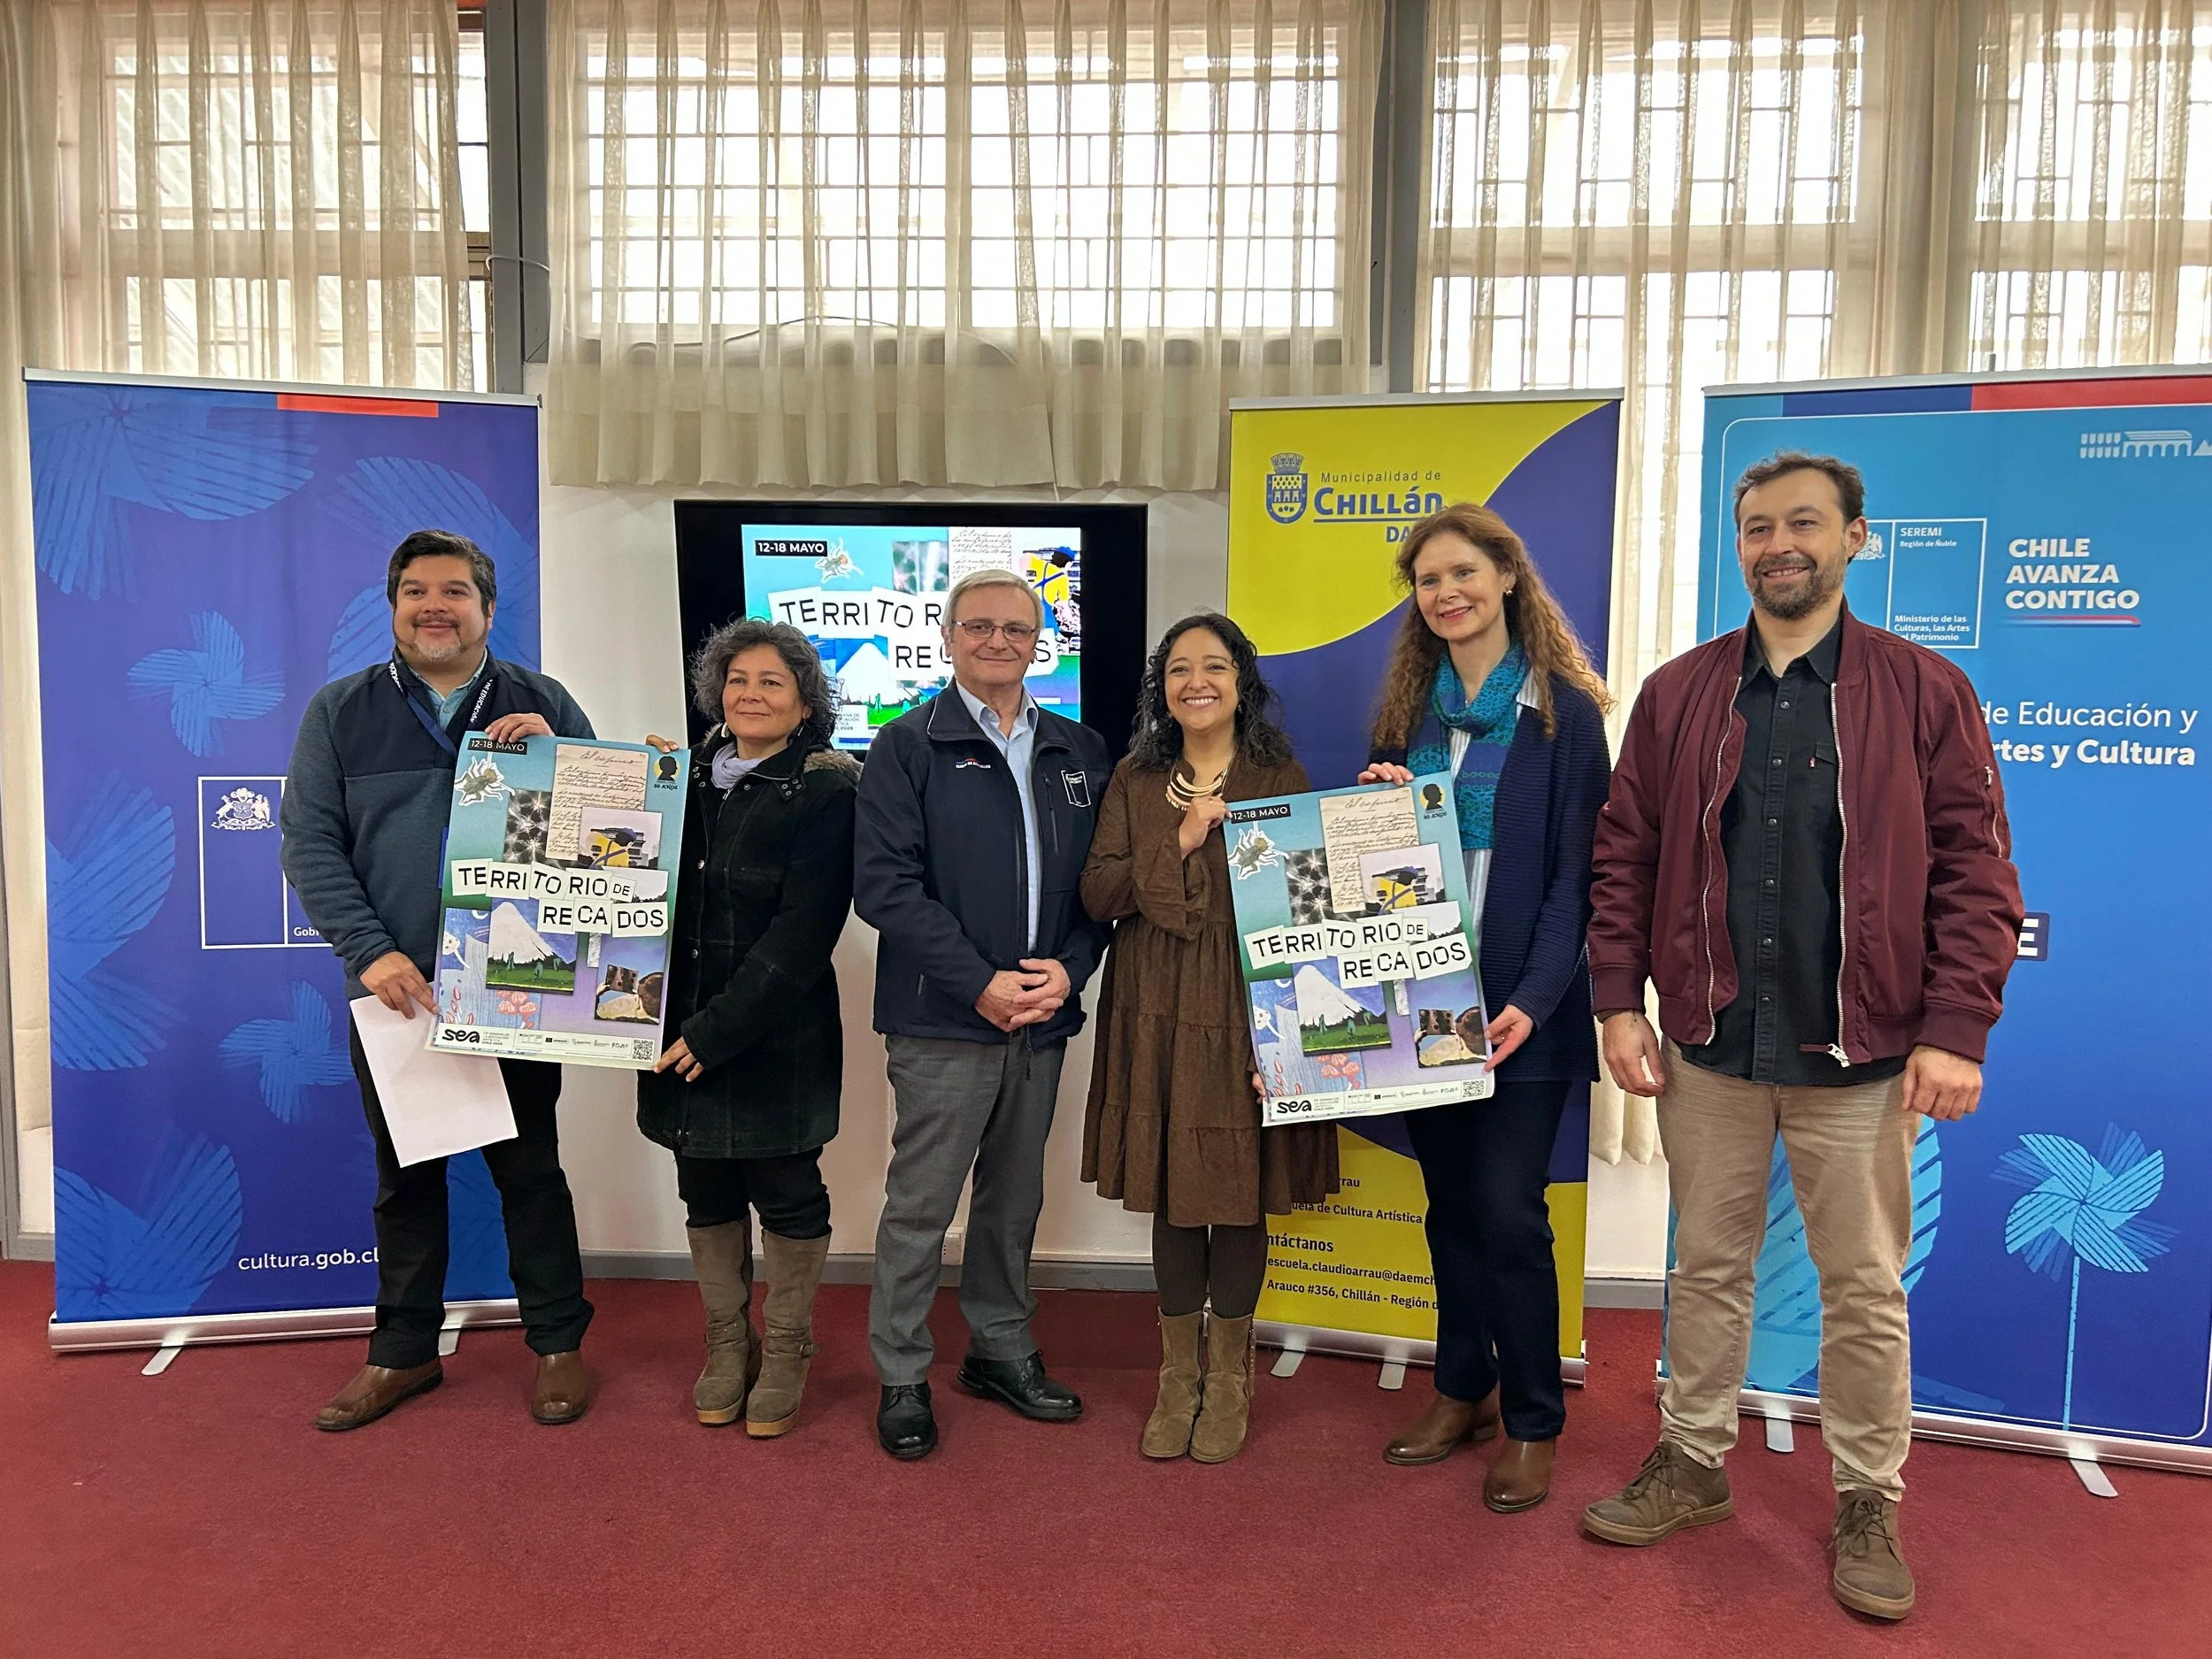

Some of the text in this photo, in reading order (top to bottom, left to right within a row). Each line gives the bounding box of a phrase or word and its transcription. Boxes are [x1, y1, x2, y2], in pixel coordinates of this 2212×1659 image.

[1321, 471, 1441, 484] Municipalidad de
[1900, 527, 1941, 537] SEREMI
[757, 542, 825, 553] 12-18 MAYO
[2008, 538, 2091, 558] CHILE
[2006, 565, 2120, 584] AVANZA
[2005, 589, 2140, 610] CONTIGO
[779, 599, 942, 628] TERRITOR
[1893, 624, 1932, 633] Culturas,
[2019, 701, 2171, 727] Educación
[2180, 709, 2199, 734] y
[472, 740, 525, 751] 12-18 MAYO
[2050, 744, 2070, 769] y
[2077, 739, 2196, 766] Cultura
[1233, 806, 1288, 820] 12-18 MAYO
[458, 866, 631, 897] TERRITORIO DE
[543, 904, 664, 929] RECADOS
[1252, 922, 1424, 957] TERRITORIO DE
[1343, 941, 1466, 979] RECADOS
[442, 1028, 480, 1043] sea
[1277, 1100, 1312, 1114] sea
[1317, 1203, 1331, 1213] de
[1333, 1204, 1373, 1218] Cultura
[1376, 1208, 1423, 1224] Artística
[1267, 1233, 1334, 1253] ntáctanos
[238, 1247, 380, 1271] cultura.gob.cl
[1267, 1257, 1434, 1286] escuela.claudioarrau@daemch
[1267, 1279, 1305, 1293] Arauco
[1307, 1285, 1339, 1299] #356,
[1341, 1287, 1380, 1302] Chillán
[1391, 1294, 1428, 1309] Región
